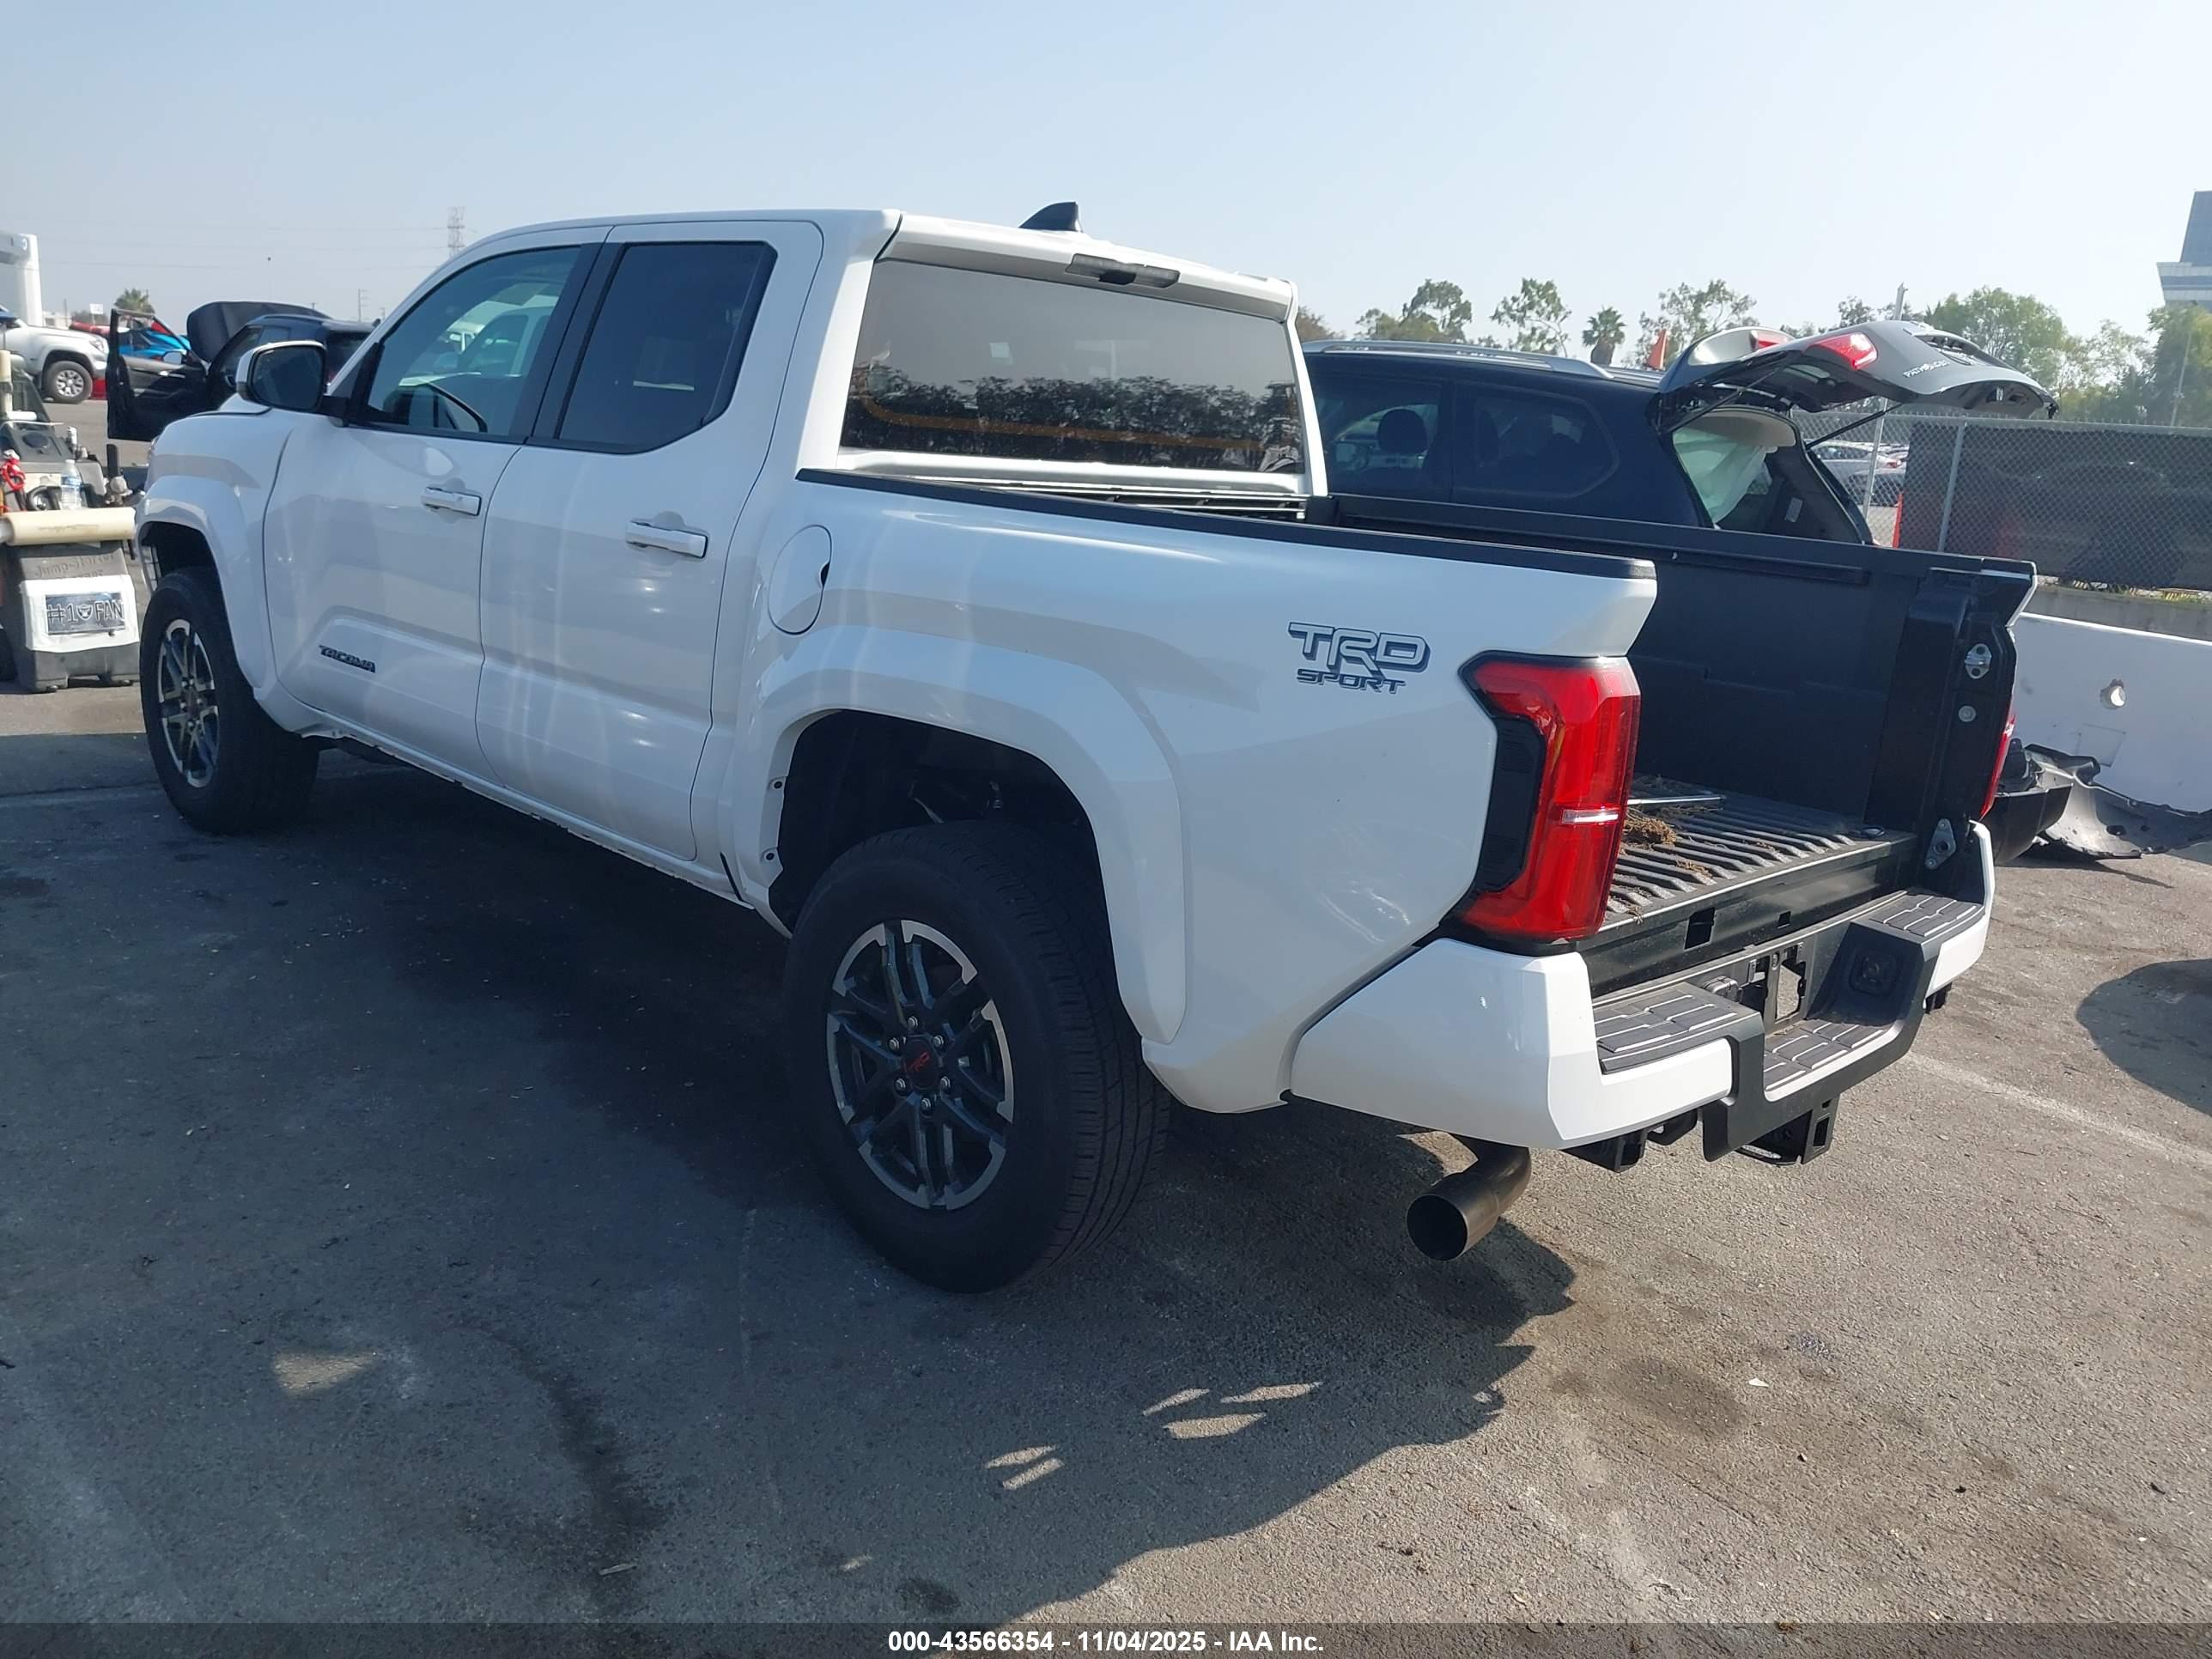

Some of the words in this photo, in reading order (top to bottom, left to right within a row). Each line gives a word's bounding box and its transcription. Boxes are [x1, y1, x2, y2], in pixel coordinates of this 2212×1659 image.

[94, 599, 125, 622] FAN
[319, 644, 375, 673] TACOMA
[1288, 622, 1431, 680] TRD
[1297, 668, 1407, 695] SPORT
